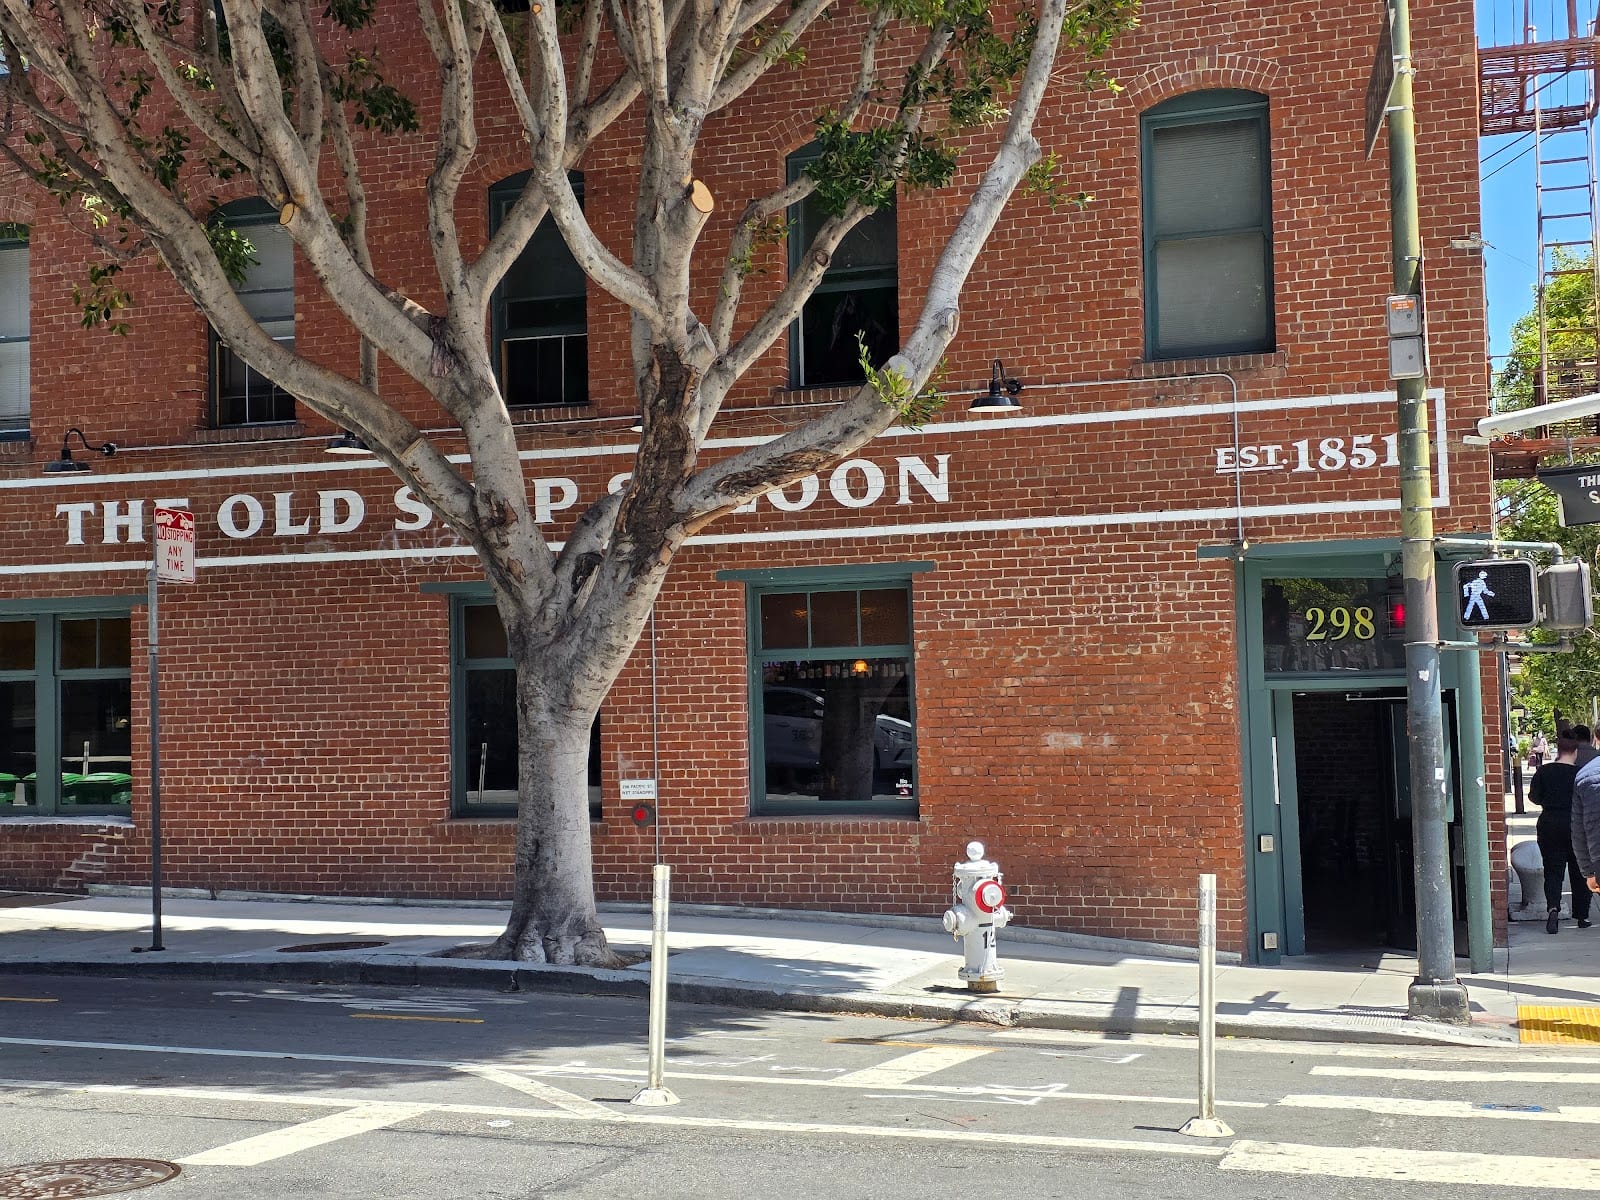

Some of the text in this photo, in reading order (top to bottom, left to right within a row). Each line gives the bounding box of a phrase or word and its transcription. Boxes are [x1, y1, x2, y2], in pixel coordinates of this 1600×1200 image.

[1215, 432, 1400, 472] EST. 1851
[217, 489, 365, 539] OLD
[394, 477, 578, 531] SP
[156, 524, 193, 543] NO STOPPING
[167, 545, 183, 557] ANY
[166, 558, 185, 572] TIME
[1305, 606, 1376, 642] 298
